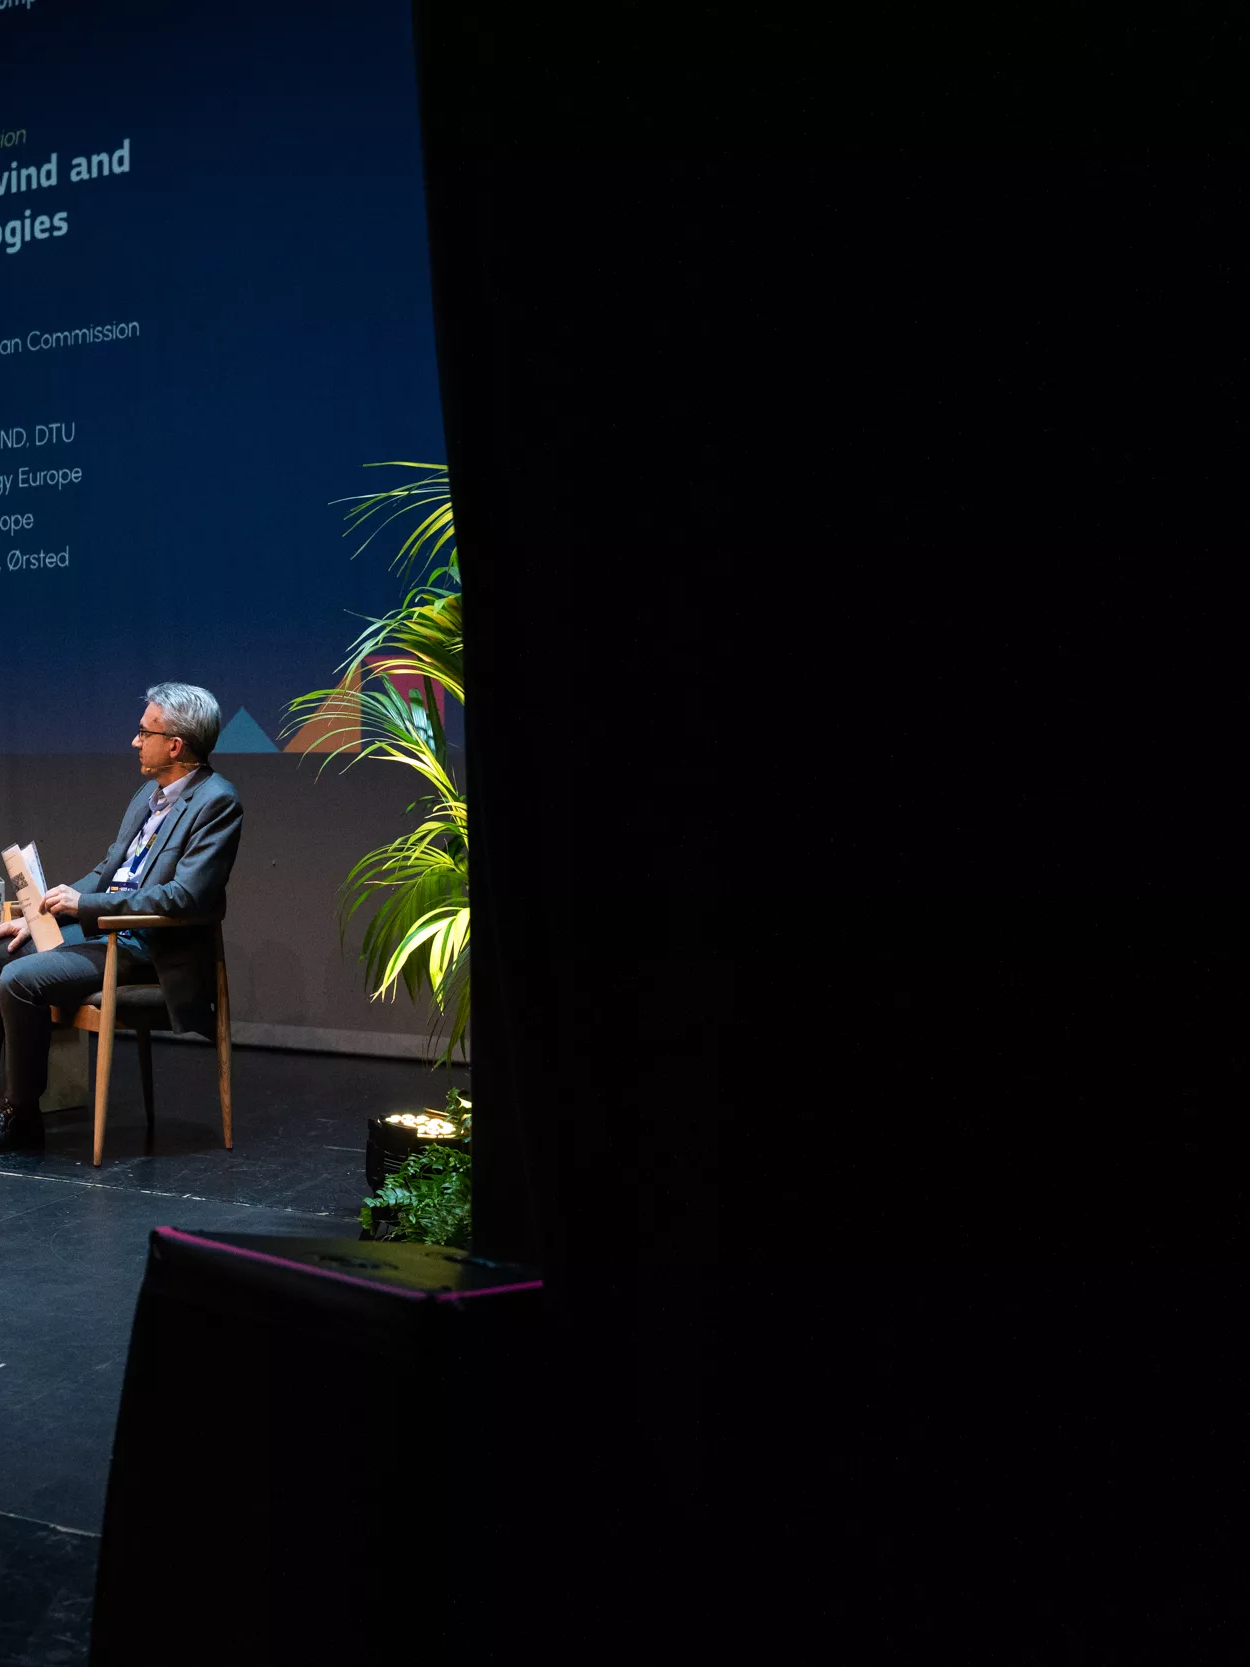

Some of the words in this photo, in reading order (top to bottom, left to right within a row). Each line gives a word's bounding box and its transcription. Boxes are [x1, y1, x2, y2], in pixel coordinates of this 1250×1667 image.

[69, 138, 131, 183] and
[26, 320, 140, 351] Commission
[35, 421, 76, 446] DTU
[18, 465, 83, 491] Europe
[6, 544, 70, 572] Ørsted
